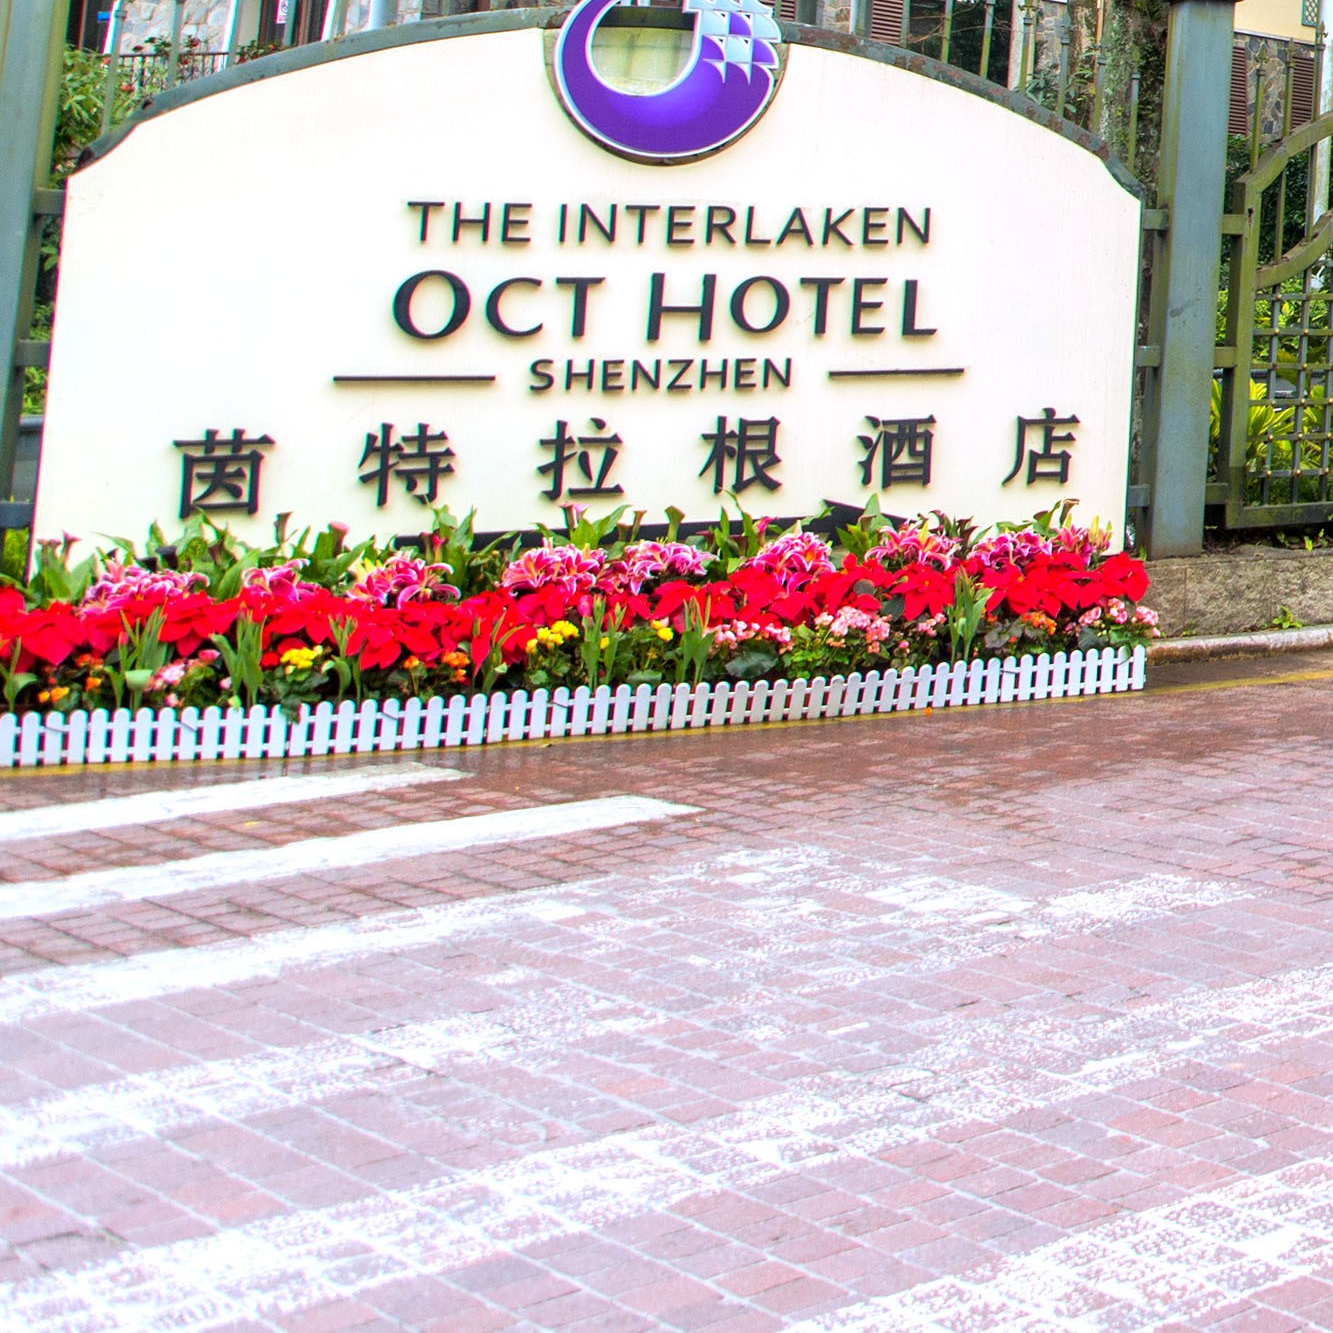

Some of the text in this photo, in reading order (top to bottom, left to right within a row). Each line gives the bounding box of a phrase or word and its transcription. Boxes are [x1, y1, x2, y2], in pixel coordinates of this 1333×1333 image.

[407, 201, 932, 246] THE INTERLAKEN
[392, 269, 939, 343] OCT HOTEL
[528, 357, 793, 393] SHENZHEN
[172, 407, 1082, 521] 茵特拉根酒店
